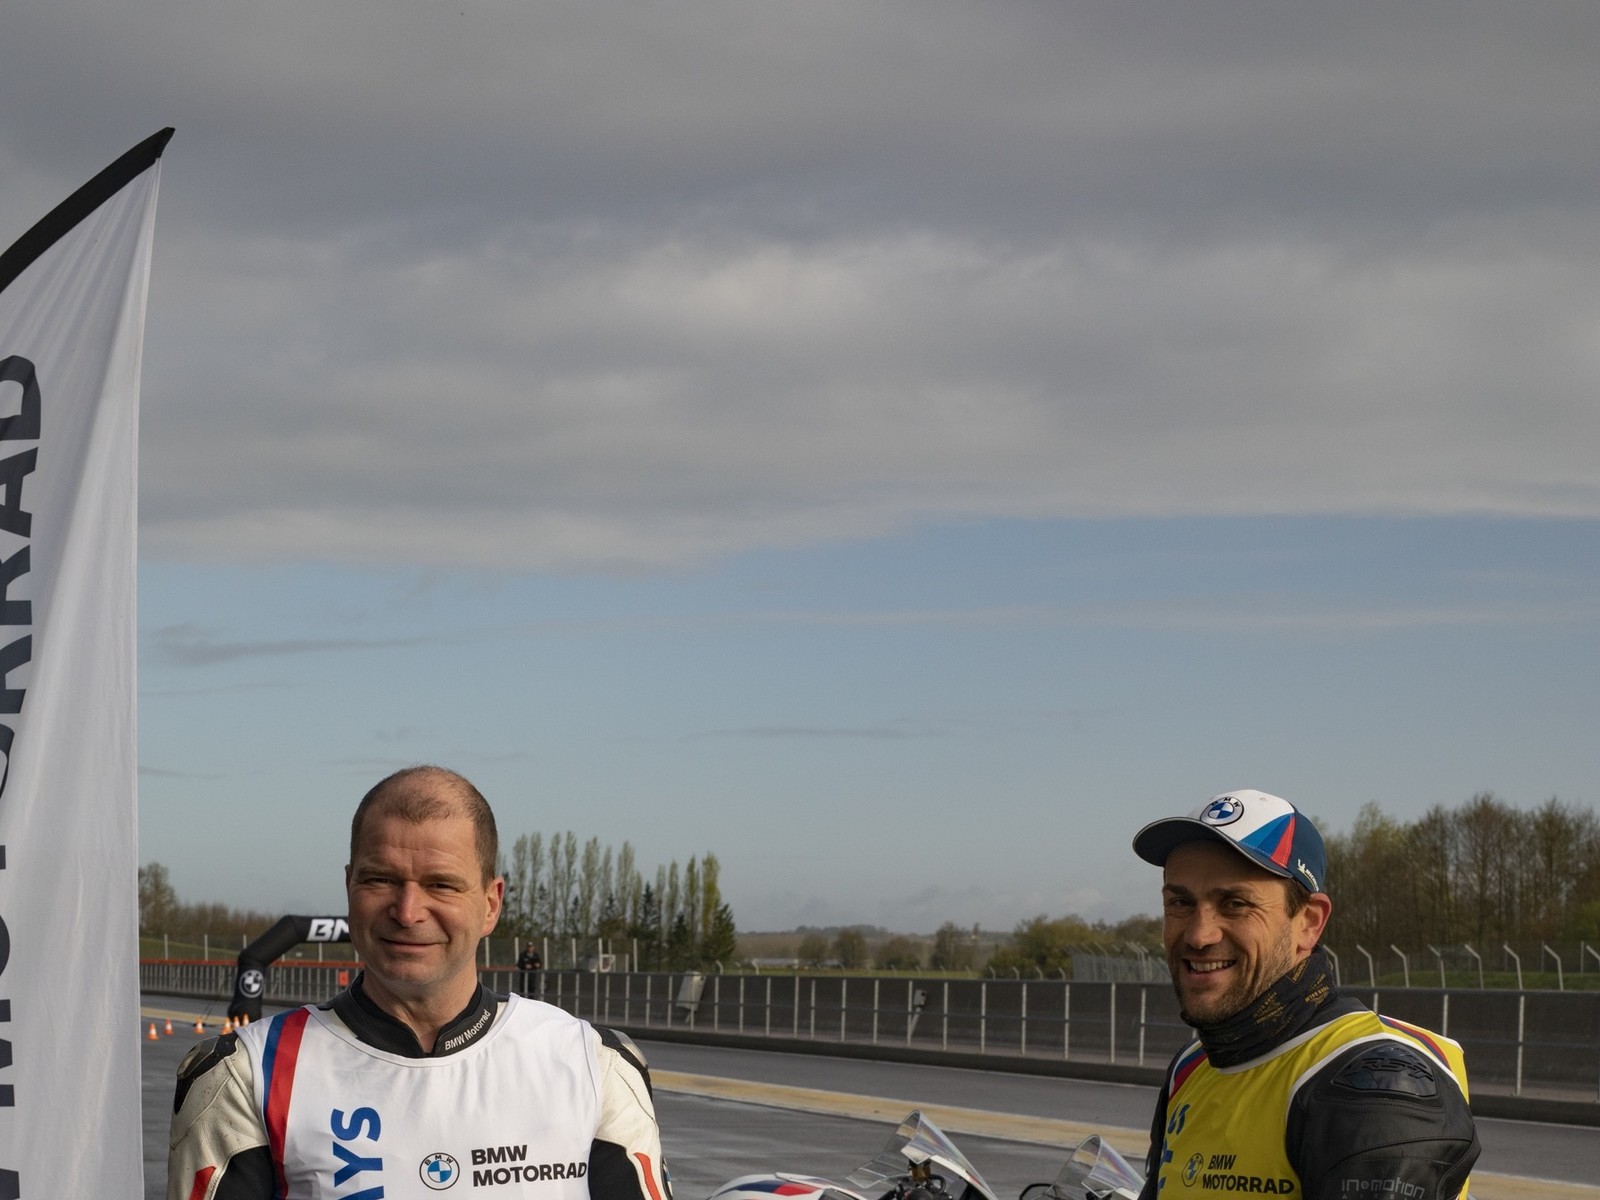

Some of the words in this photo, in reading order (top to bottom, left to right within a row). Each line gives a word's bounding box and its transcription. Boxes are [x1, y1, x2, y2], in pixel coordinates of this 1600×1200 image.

[444, 1034, 465, 1051] BMW
[463, 1008, 491, 1041] Motorrad
[471, 1144, 528, 1166] BMW
[1207, 1153, 1238, 1171] BMW
[473, 1162, 588, 1188] MOTORRAD
[1201, 1173, 1295, 1195] MOTORRAD
